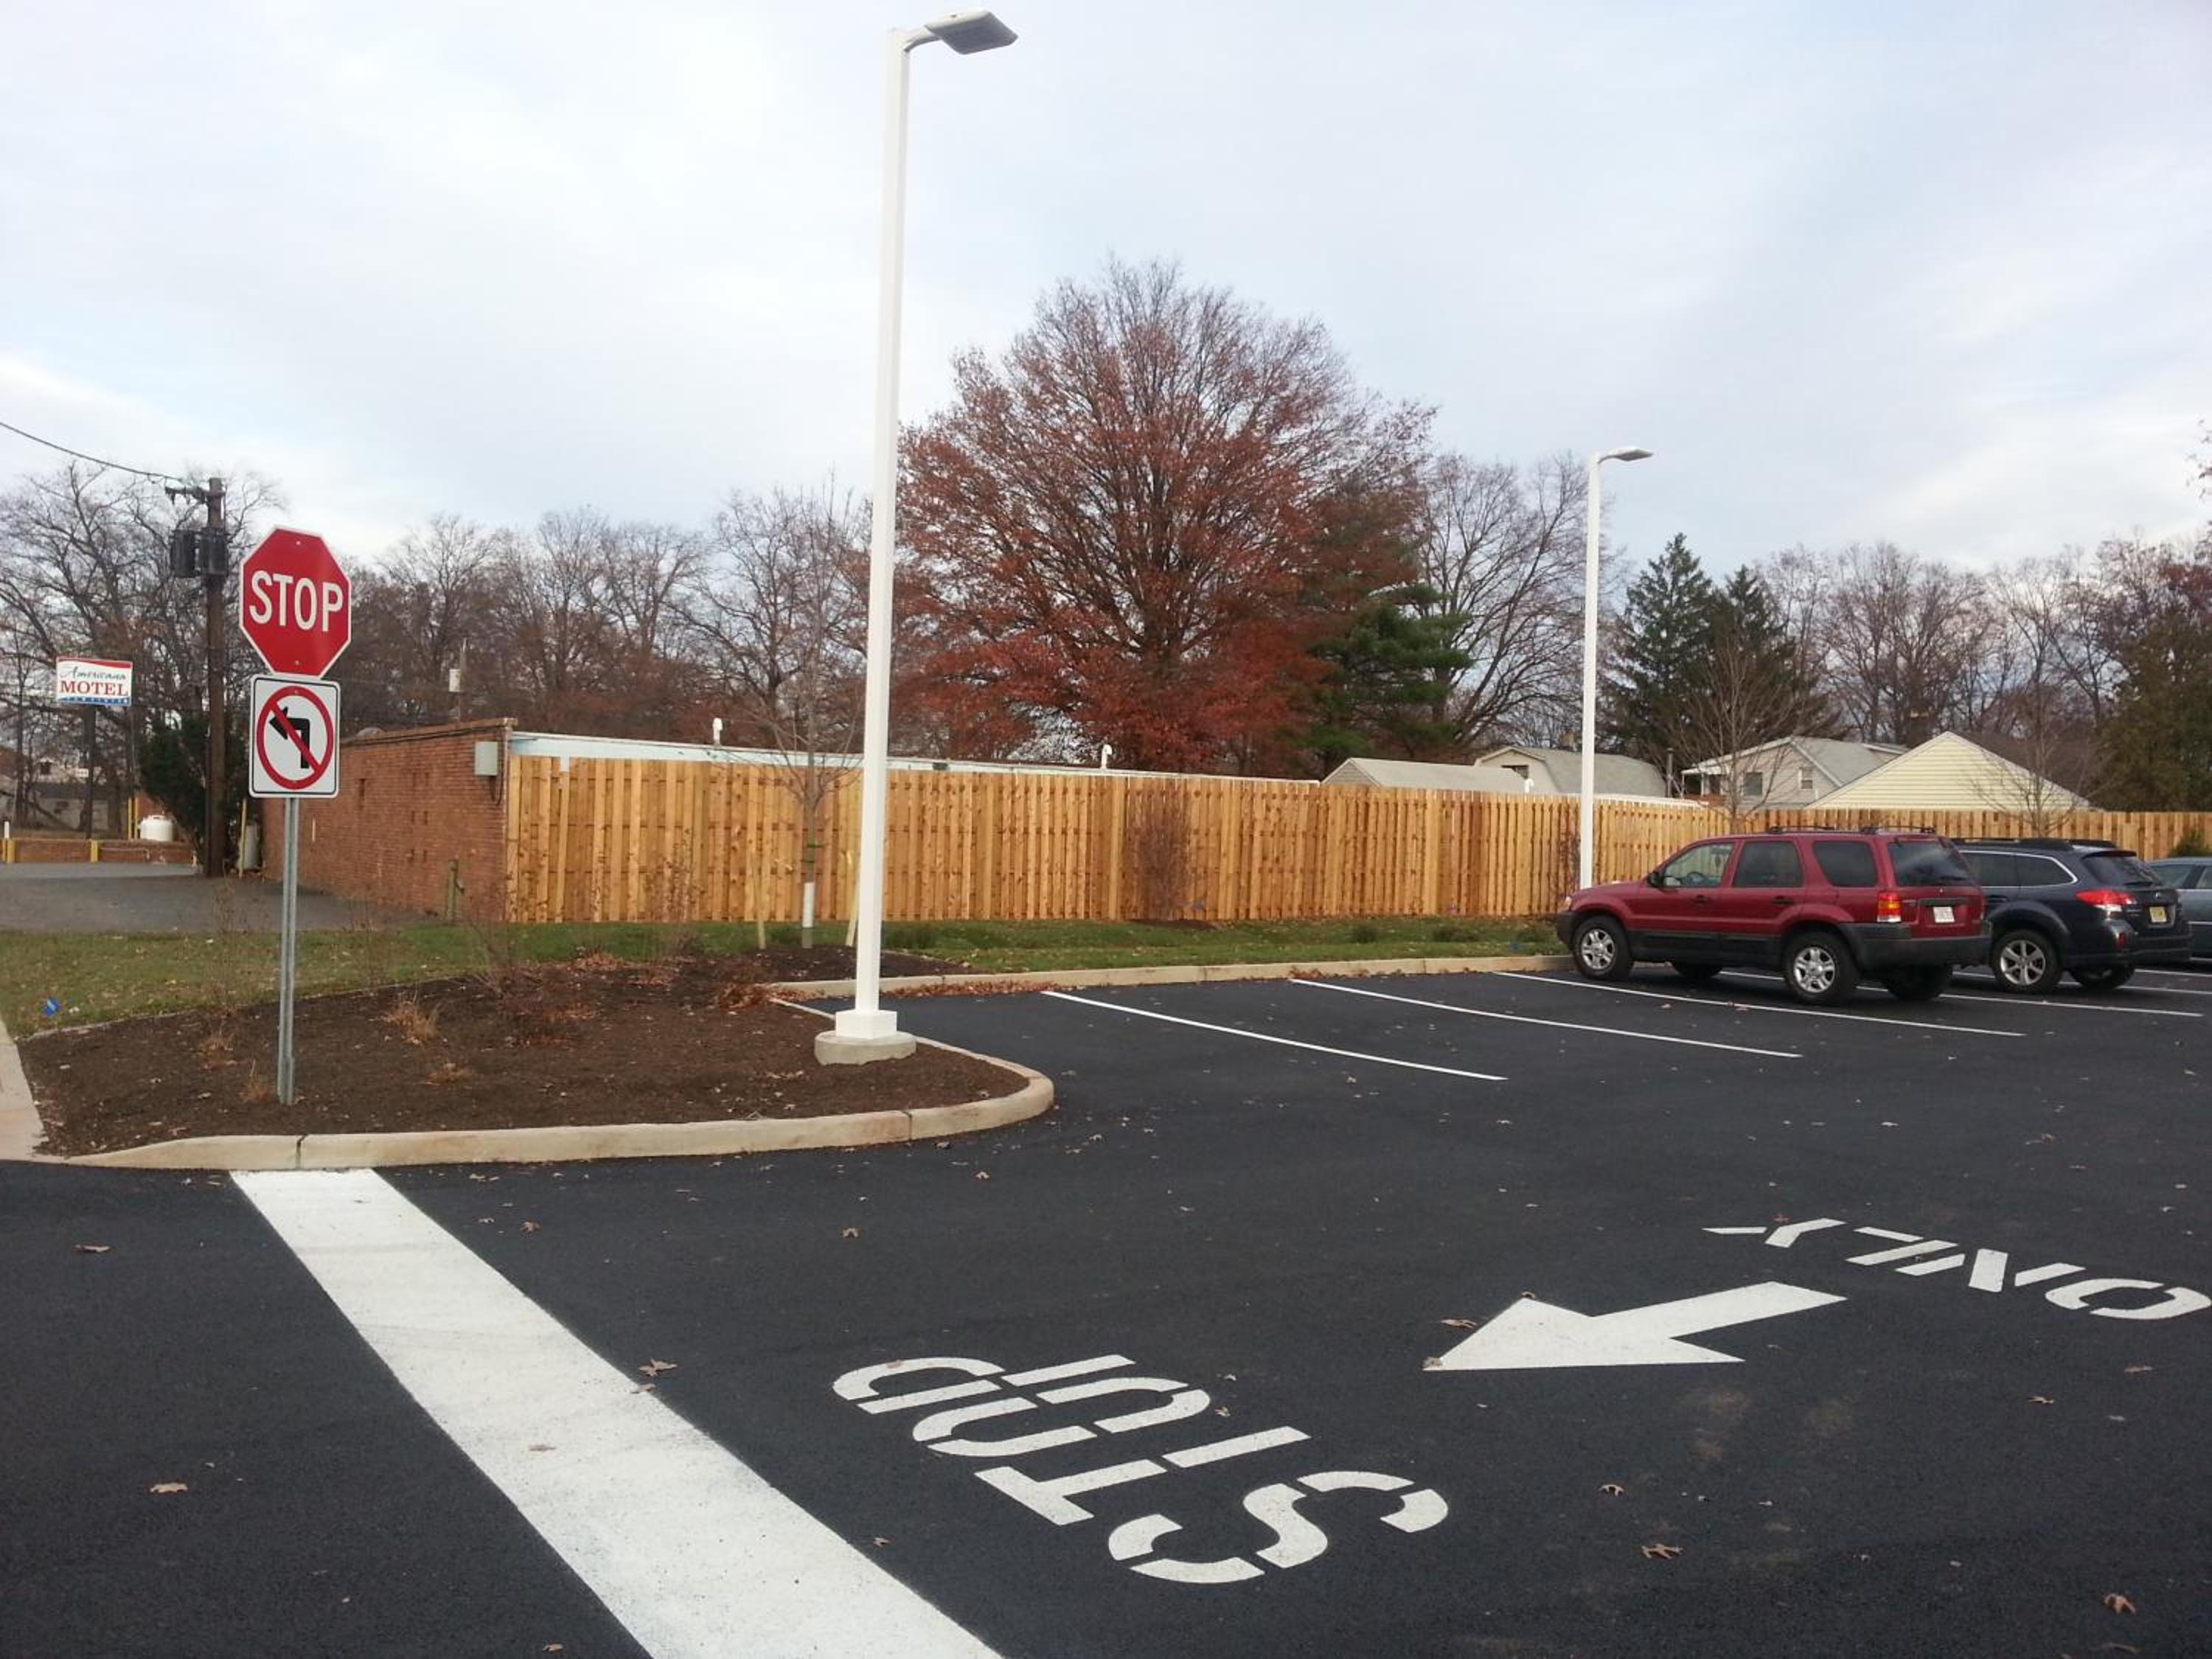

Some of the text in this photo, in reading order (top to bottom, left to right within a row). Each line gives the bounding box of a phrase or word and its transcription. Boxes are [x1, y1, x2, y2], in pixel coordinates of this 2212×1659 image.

[249, 570, 343, 632] STOP
[60, 681, 129, 696] MOTEL
[1702, 1218, 2212, 1320] ONLY
[832, 1354, 1448, 1584] STOP
